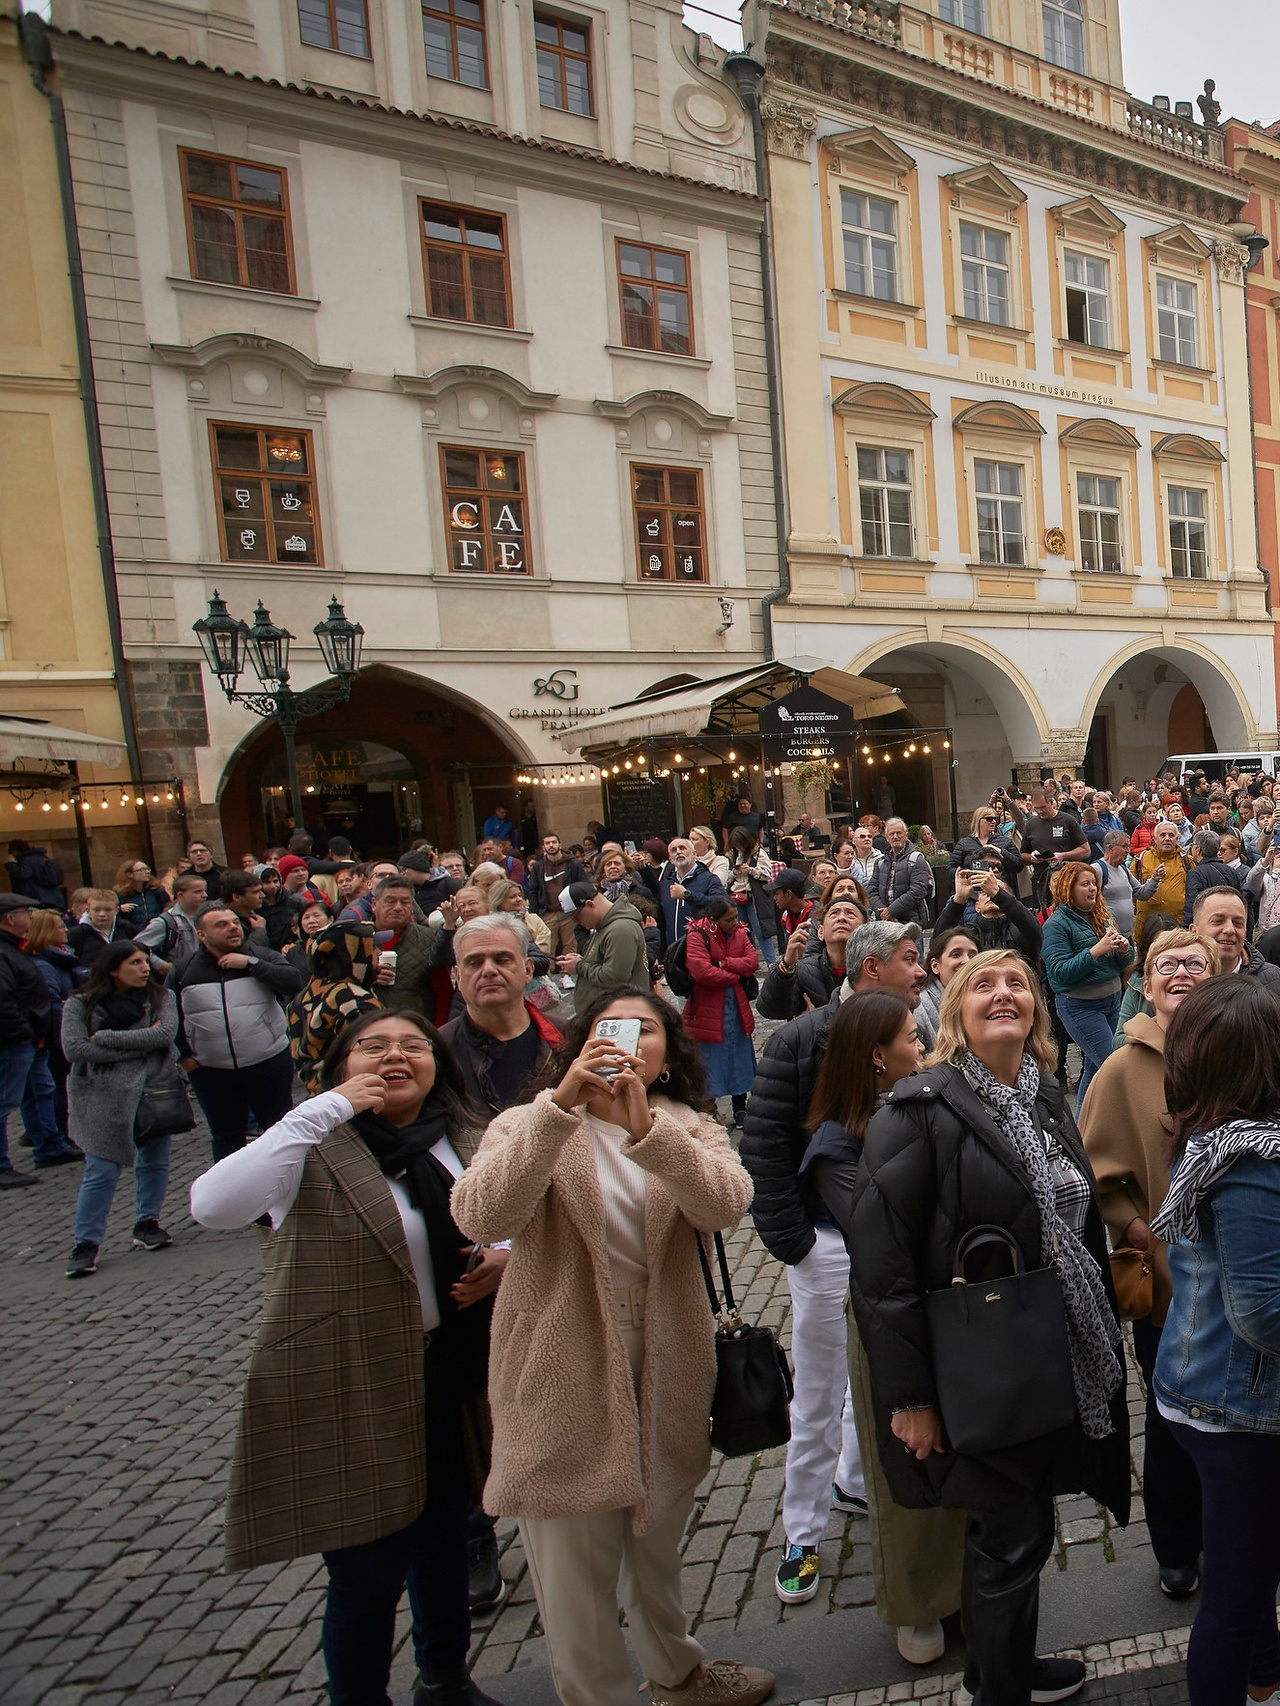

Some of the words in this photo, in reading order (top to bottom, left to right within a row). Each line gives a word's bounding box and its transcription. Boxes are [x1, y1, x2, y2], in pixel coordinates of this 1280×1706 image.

[976, 372, 1018, 388] illusion
[1020, 381, 1036, 391] art
[1039, 384, 1079, 398] museum
[1082, 392, 1114, 405] prague
[678, 520, 695, 528] open
[509, 708, 562, 720] GRAND
[794, 726, 826, 734] STEAKS
[790, 737, 830, 746] BURGERS
